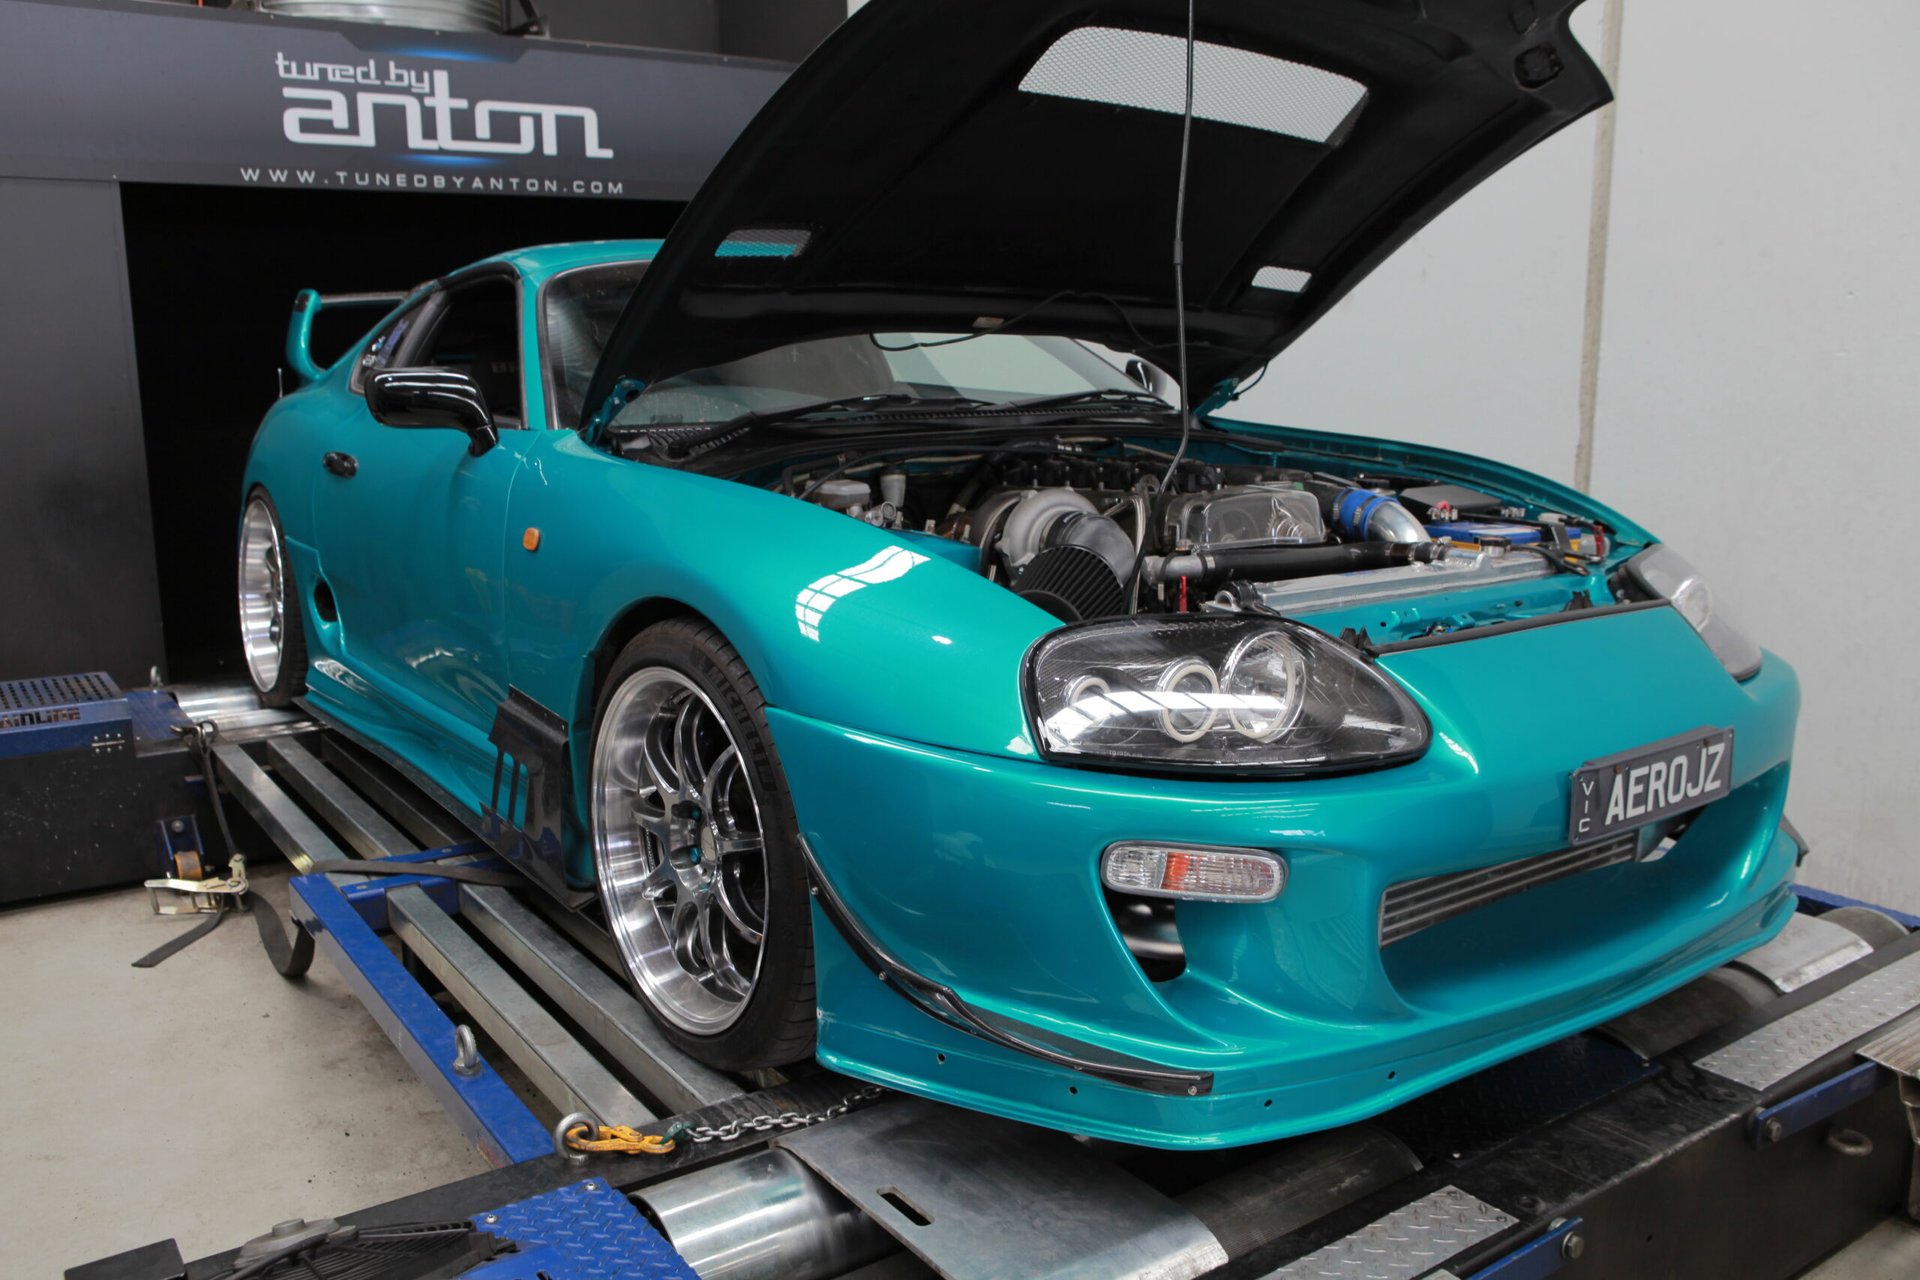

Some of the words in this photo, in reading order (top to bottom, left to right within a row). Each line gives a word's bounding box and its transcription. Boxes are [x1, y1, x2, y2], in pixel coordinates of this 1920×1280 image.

[275, 51, 381, 85] tuned
[384, 60, 431, 93] by
[282, 69, 615, 159] anton
[240, 167, 624, 194] WWW.TUNEDBYANTON.COM
[1578, 781, 1595, 832] VIC
[1604, 742, 1725, 826] AEROJZ
